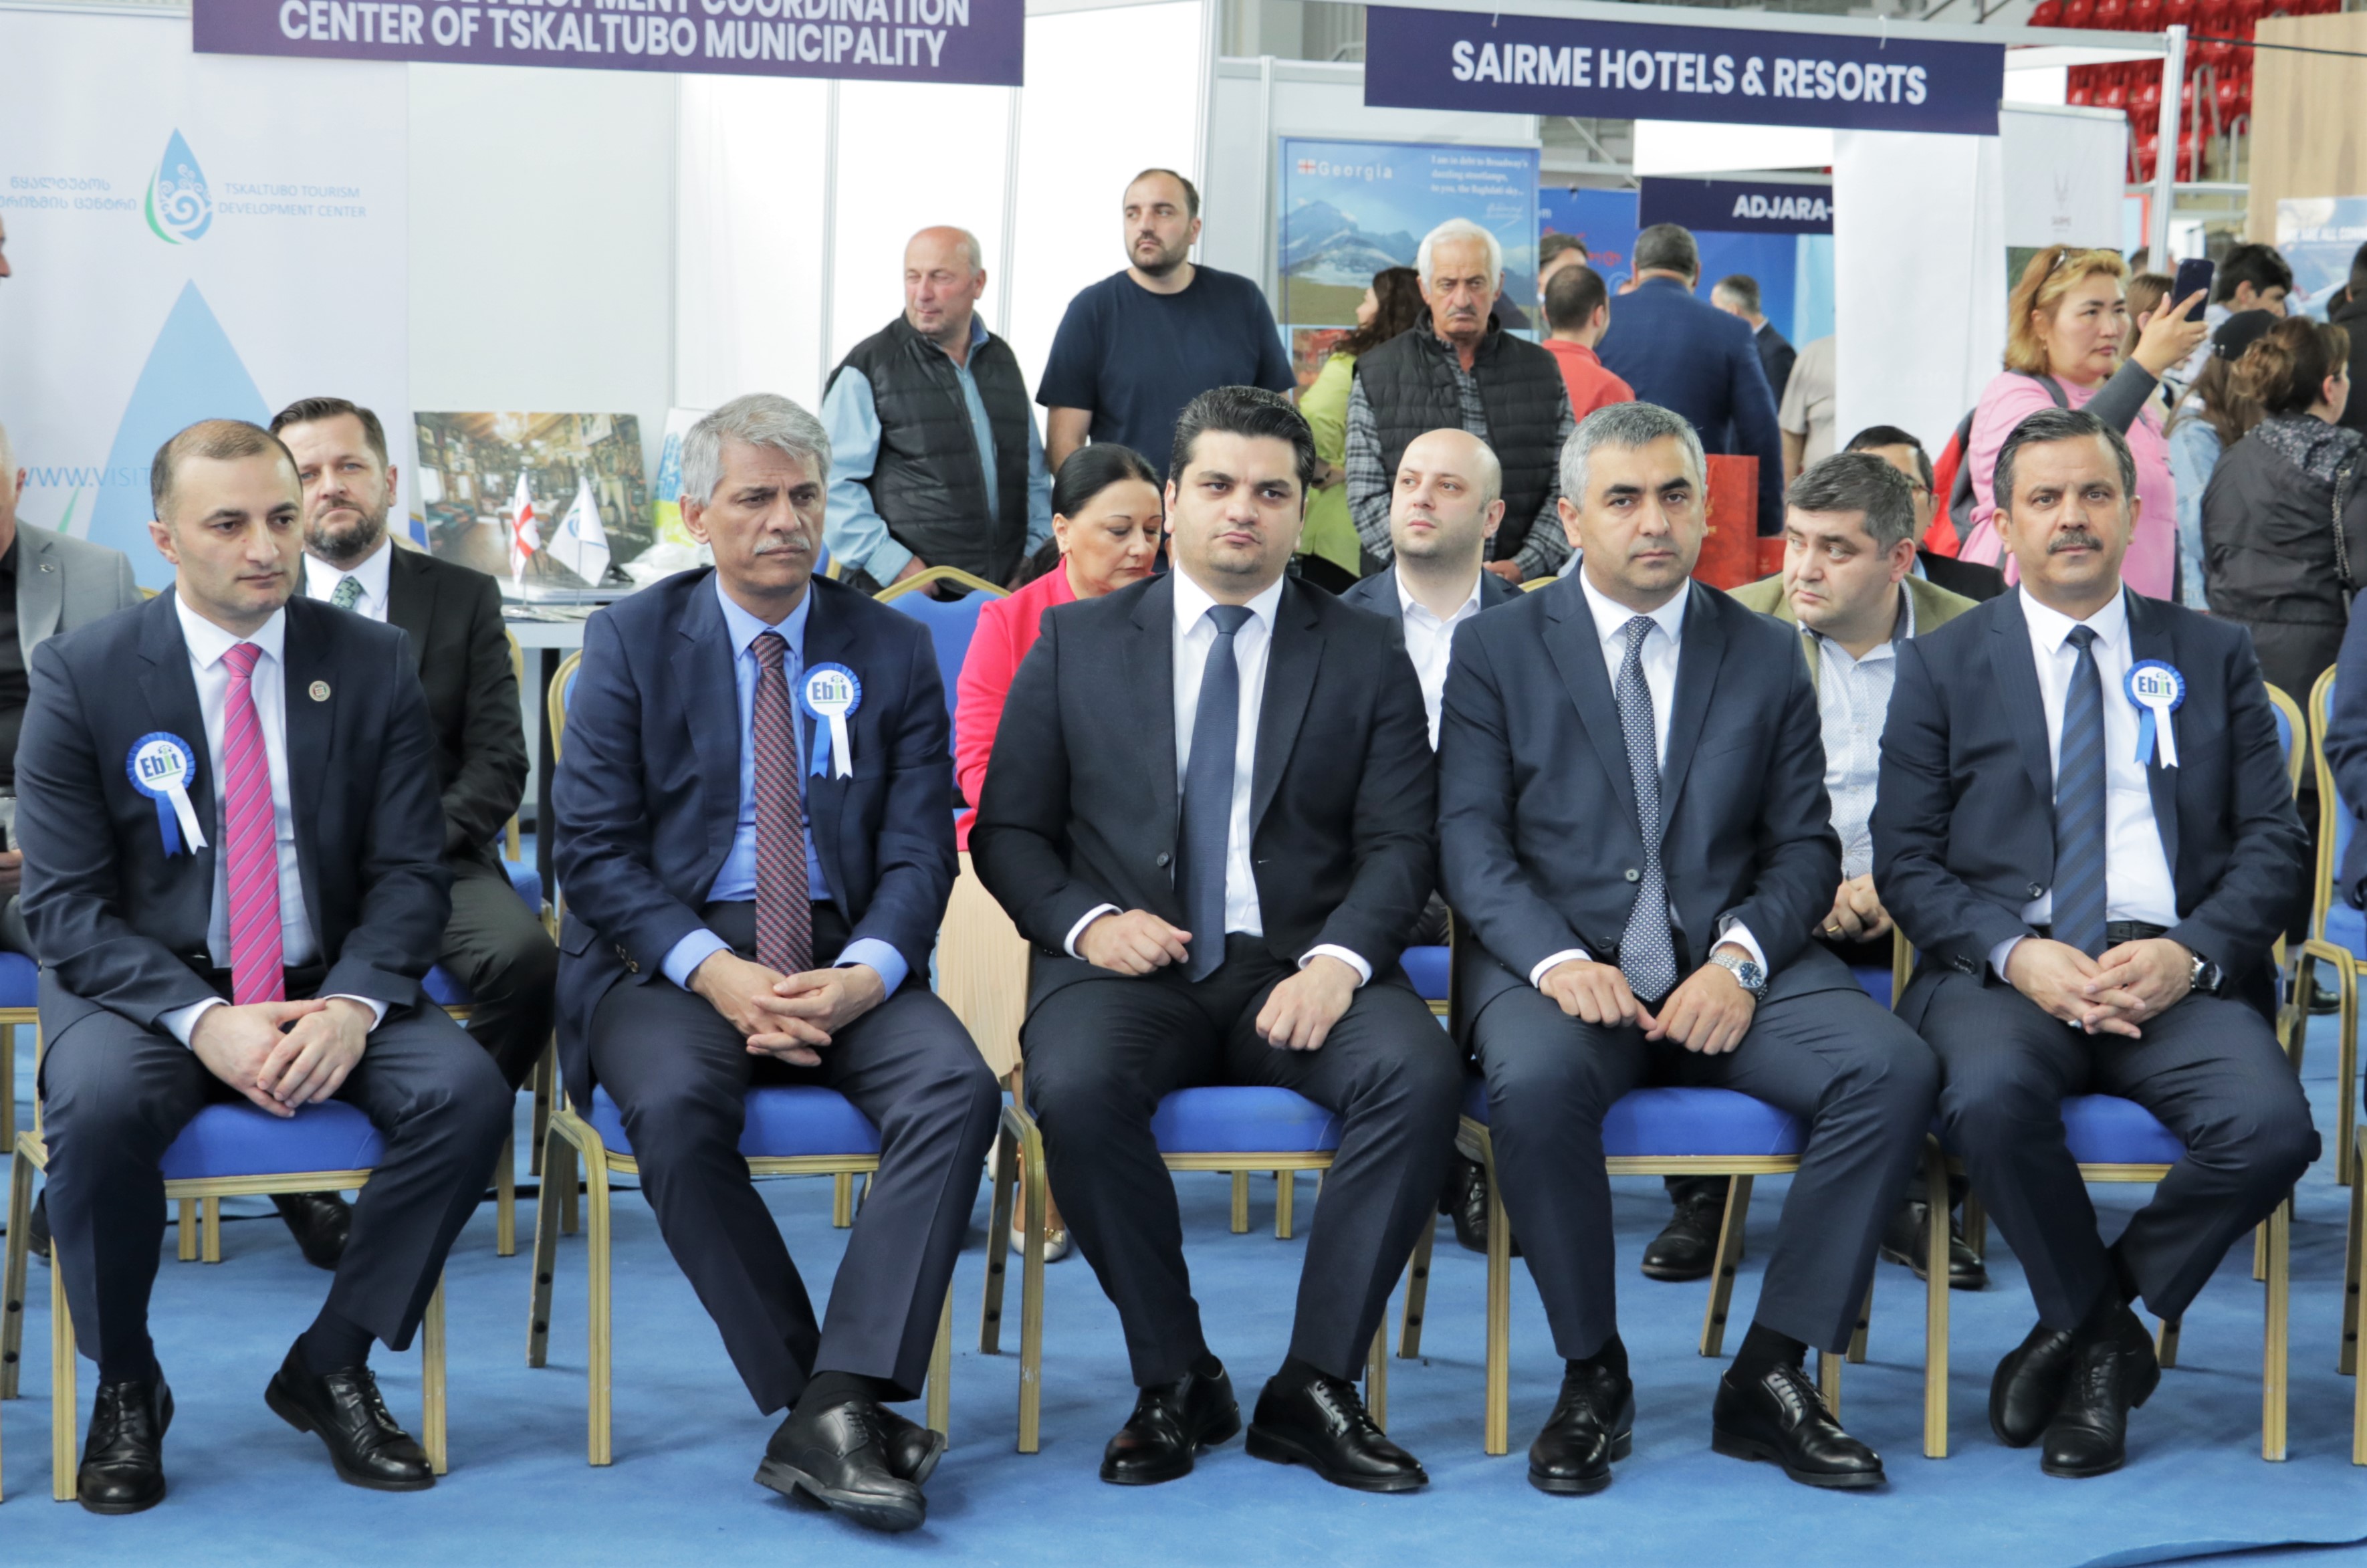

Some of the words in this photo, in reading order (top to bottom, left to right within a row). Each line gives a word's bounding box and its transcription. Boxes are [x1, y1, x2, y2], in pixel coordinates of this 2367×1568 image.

[279, 0, 424, 45] CENTER
[431, 5, 479, 47] OF
[487, 8, 697, 57] TSKALTUBO
[705, 19, 947, 67] MUNICIPALITY
[1452, 40, 1591, 87] SAIRME
[1600, 48, 1734, 94] HOTELS
[1741, 56, 1767, 97] &
[1774, 59, 1927, 105] RESORTS
[1318, 160, 1393, 182] Georgia
[225, 183, 298, 197] TSKALTUBO
[302, 185, 360, 199] TOURISM
[219, 201, 314, 216] DEVELOPMENT
[318, 205, 367, 218] CENTER
[812, 677, 848, 700] Ebit
[2138, 674, 2172, 695] Ebit
[139, 747, 181, 778] Ebit
